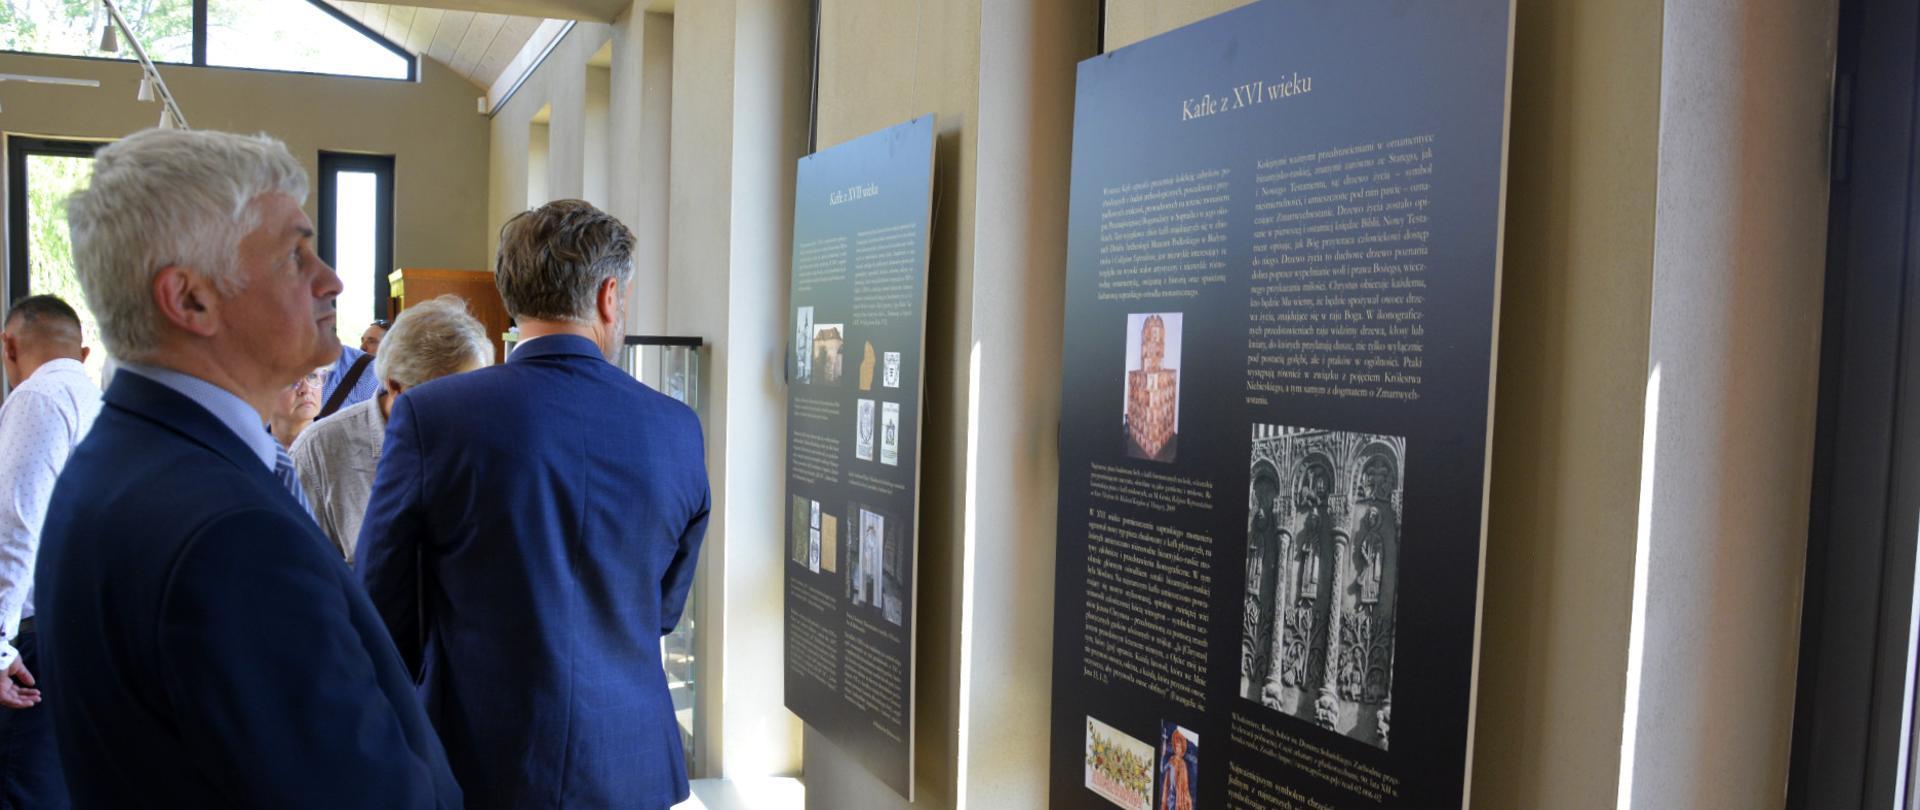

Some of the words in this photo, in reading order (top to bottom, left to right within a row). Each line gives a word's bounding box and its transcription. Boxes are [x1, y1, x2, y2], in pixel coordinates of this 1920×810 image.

[1182, 93, 1217, 121] Kafle
[1220, 96, 1229, 112] z
[1232, 80, 1263, 110] XVI
[1267, 72, 1312, 101] wieku
